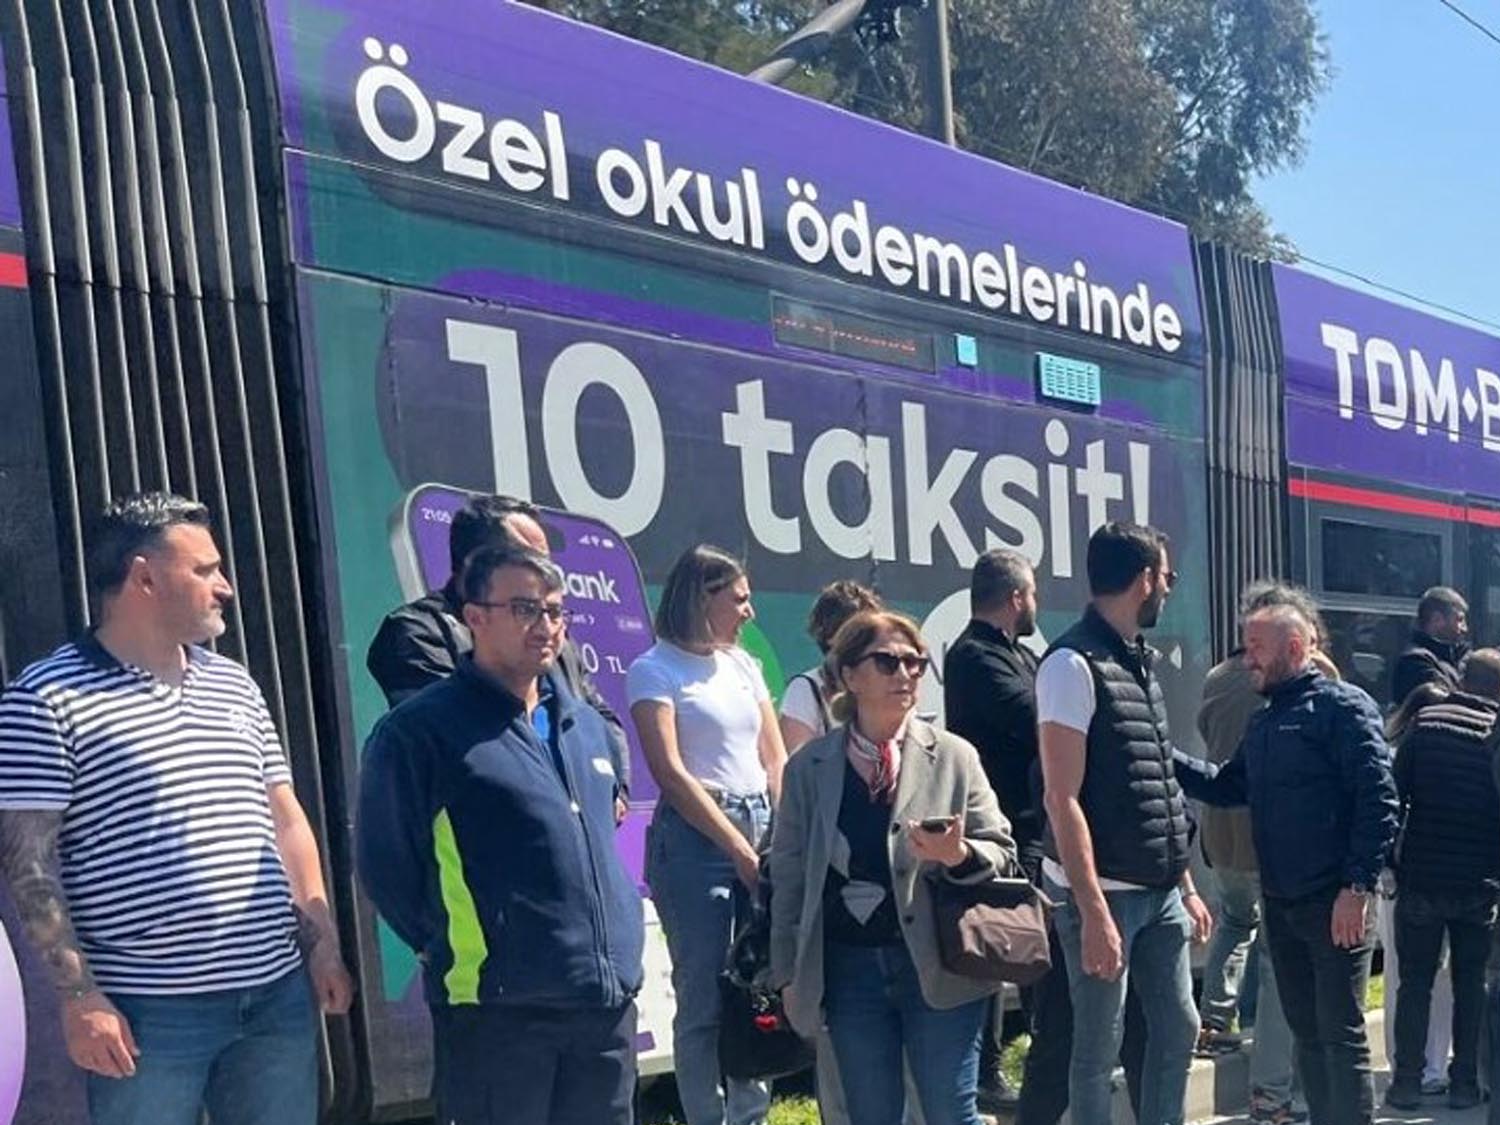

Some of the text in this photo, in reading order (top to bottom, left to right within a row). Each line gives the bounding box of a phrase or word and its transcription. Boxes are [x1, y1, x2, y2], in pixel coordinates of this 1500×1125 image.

[356, 37, 1183, 353] Özel okul ödemelerinde
[446, 319, 665, 538] 10
